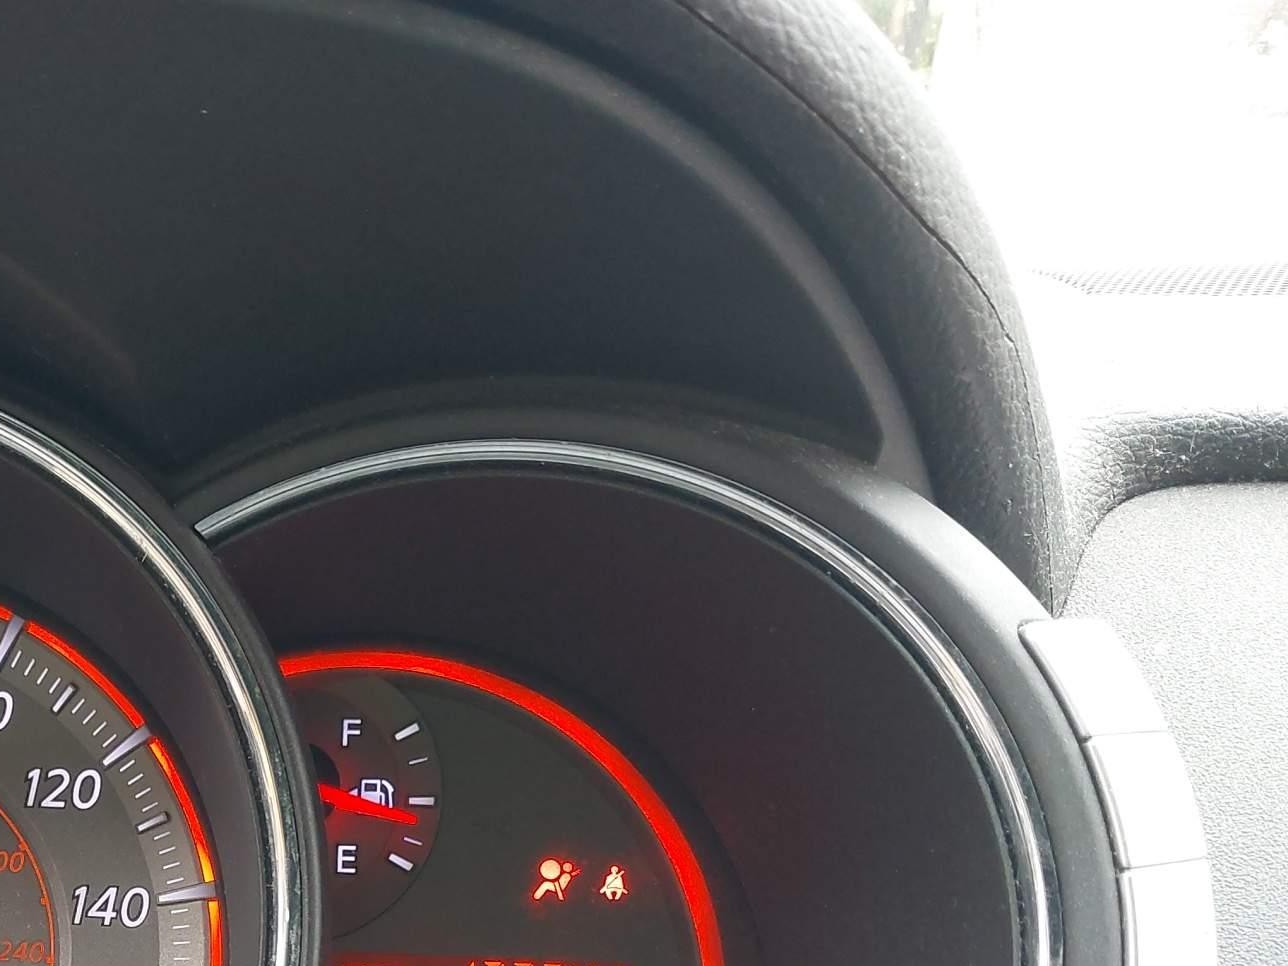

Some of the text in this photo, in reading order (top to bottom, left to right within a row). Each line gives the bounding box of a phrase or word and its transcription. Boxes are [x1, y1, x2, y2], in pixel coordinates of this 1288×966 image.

[341, 719, 362, 746] F
[25, 768, 102, 810] 120
[336, 846, 357, 874] E
[73, 886, 149, 928] 140
